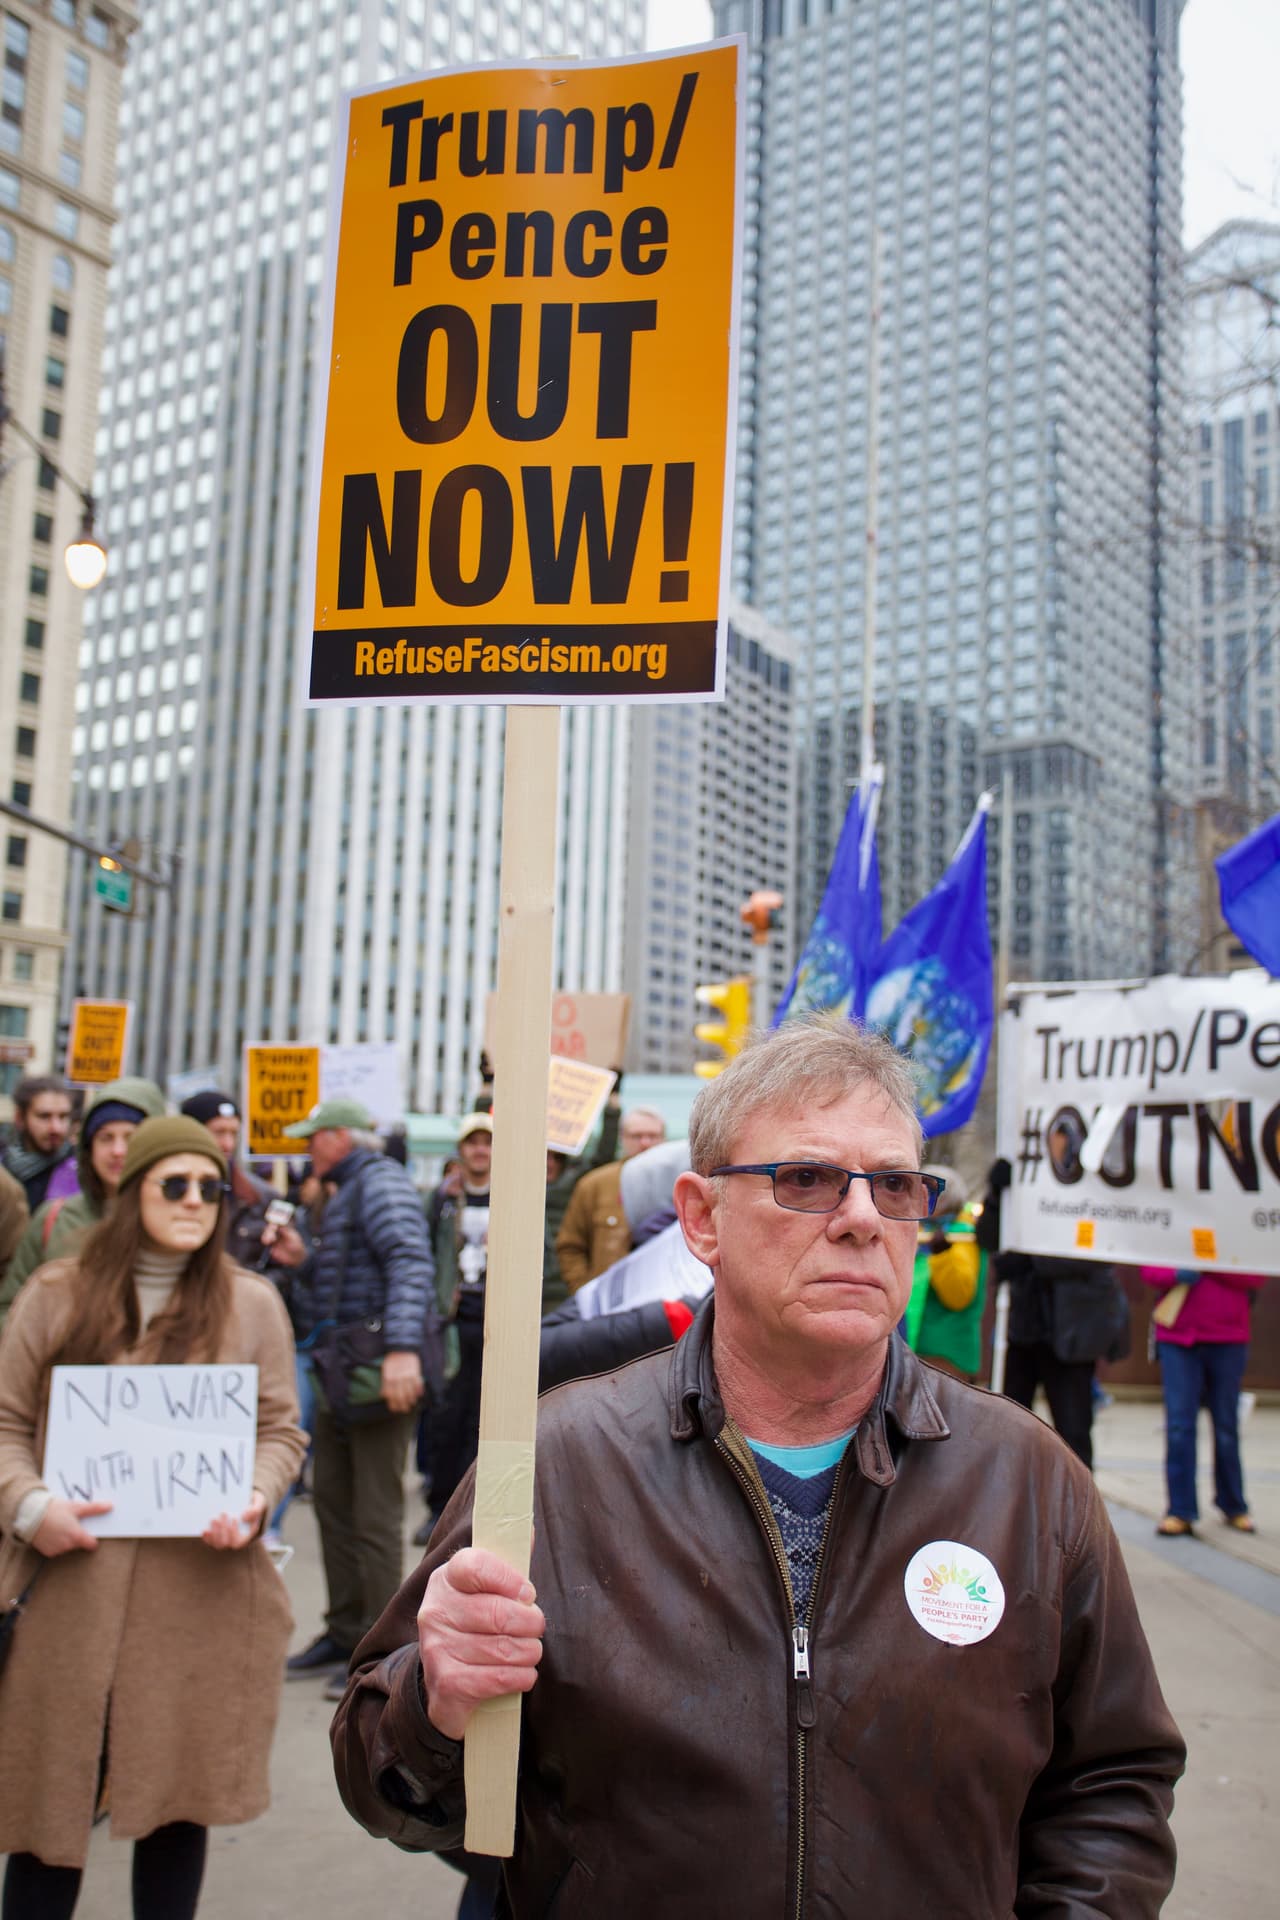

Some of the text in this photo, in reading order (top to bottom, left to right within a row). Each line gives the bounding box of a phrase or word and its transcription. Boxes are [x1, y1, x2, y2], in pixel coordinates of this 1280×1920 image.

[381, 71, 700, 193] Trump/
[393, 198, 669, 287] Pence
[396, 299, 658, 445] OUT
[337, 461, 695, 610] NOW!
[355, 638, 668, 680] RefuseFascism.org
[1035, 1009, 1280, 1090] Trump/Pe
[260, 1089, 306, 1112] OUT
[64, 1370, 252, 1427] NO WAR
[57, 1440, 246, 1511] WITH IRAN
[921, 1596, 963, 1609] MOVEMENT
[965, 1602, 981, 1611] FOR
[921, 1606, 988, 1623] PEOPLE'S PARTY
